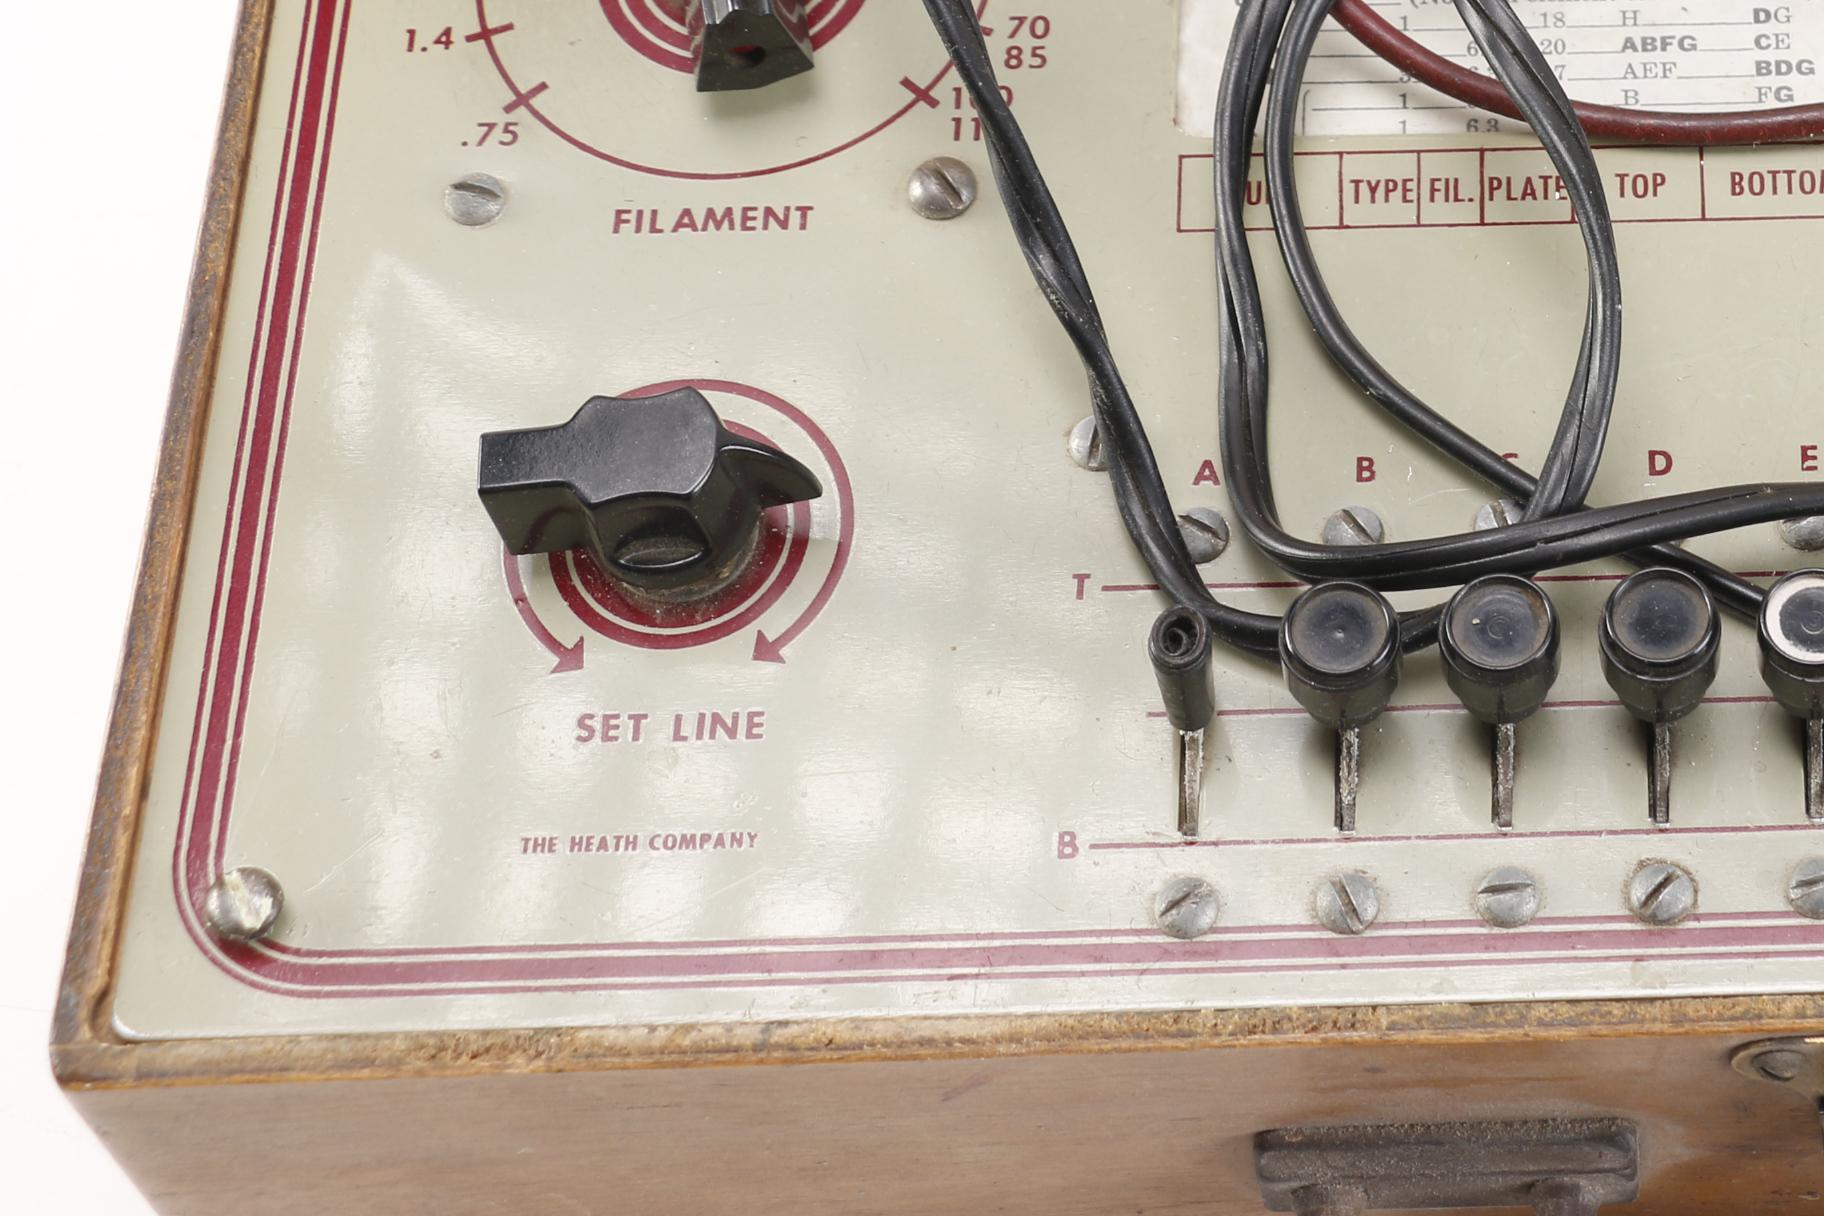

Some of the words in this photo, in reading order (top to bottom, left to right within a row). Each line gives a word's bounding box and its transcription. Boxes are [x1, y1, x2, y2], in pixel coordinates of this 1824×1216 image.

[1008, 15, 1051, 40] 70
[1540, 12, 1566, 29] 18
[1620, 10, 1640, 27] H
[1753, 7, 1792, 25] DG
[405, 27, 454, 52] 1.4
[1540, 39, 1566, 56] 20
[1621, 35, 1698, 53] ABFG
[1754, 33, 1791, 50] CE
[1003, 45, 1048, 70] 85
[1622, 62, 1677, 79] AEF
[1755, 59, 1816, 77] BDG
[951, 85, 1014, 110] 10
[1621, 89, 1640, 106] B
[1755, 86, 1795, 104] FG
[459, 123, 520, 148] .75
[1350, 178, 1415, 205] TYPE
[1429, 177, 1474, 204] FIL.
[1489, 175, 1568, 202] PLATE
[1614, 172, 1667, 199] TOP
[612, 205, 815, 234] FILAMENT
[1355, 456, 1376, 482] B
[1647, 450, 1673, 476] D
[1801, 445, 1819, 471] E
[1192, 459, 1221, 486] A
[1071, 573, 1092, 600] T
[576, 713, 648, 742] SET
[672, 711, 765, 741] LINE
[521, 836, 557, 854] THE
[569, 834, 638, 853] HEATH
[648, 831, 758, 852] COMPANY
[1056, 831, 1078, 859] B
